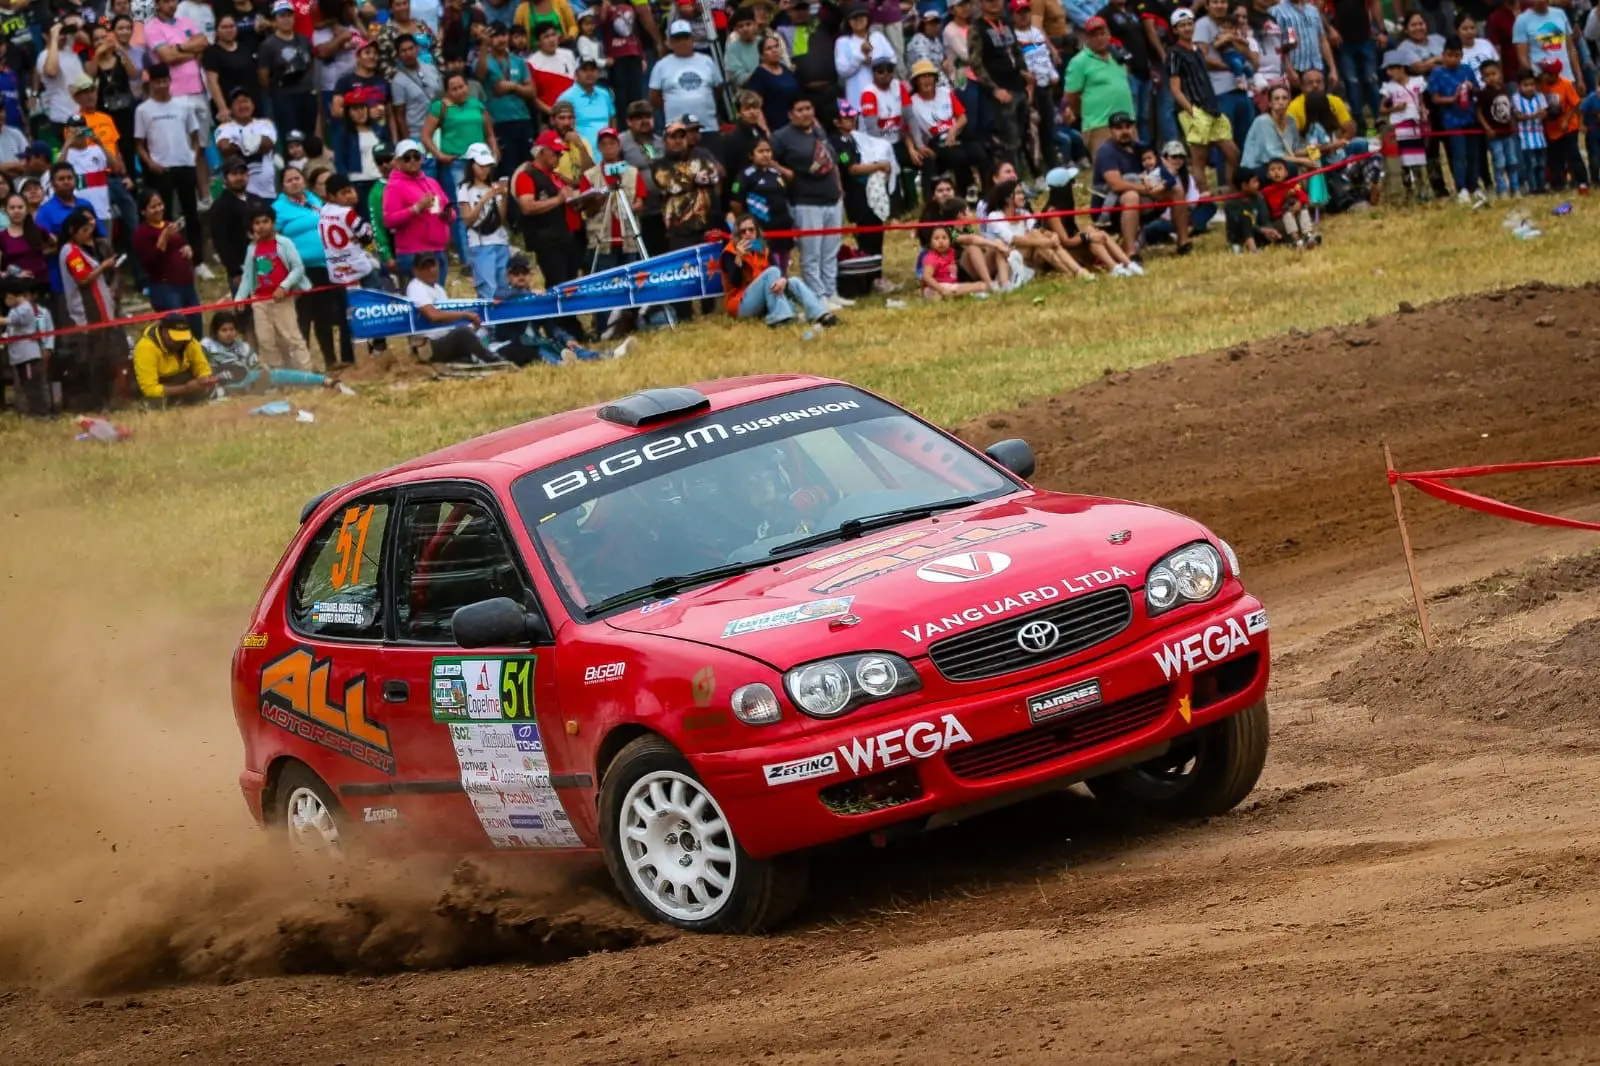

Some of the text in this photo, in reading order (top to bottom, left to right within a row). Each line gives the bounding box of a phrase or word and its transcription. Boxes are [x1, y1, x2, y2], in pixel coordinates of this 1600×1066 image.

[731, 400, 860, 435] SUSPENSION
[332, 504, 375, 589] 51
[901, 564, 1137, 642] VANGUARD LTDA.
[1153, 618, 1249, 681] WEGA
[260, 649, 391, 752] ALL
[467, 694, 500, 717] Copelme
[503, 661, 531, 718] 51
[262, 700, 394, 772] MOTORSPORT
[768, 755, 834, 779] ZESTINO
[838, 713, 973, 776] WEGA
